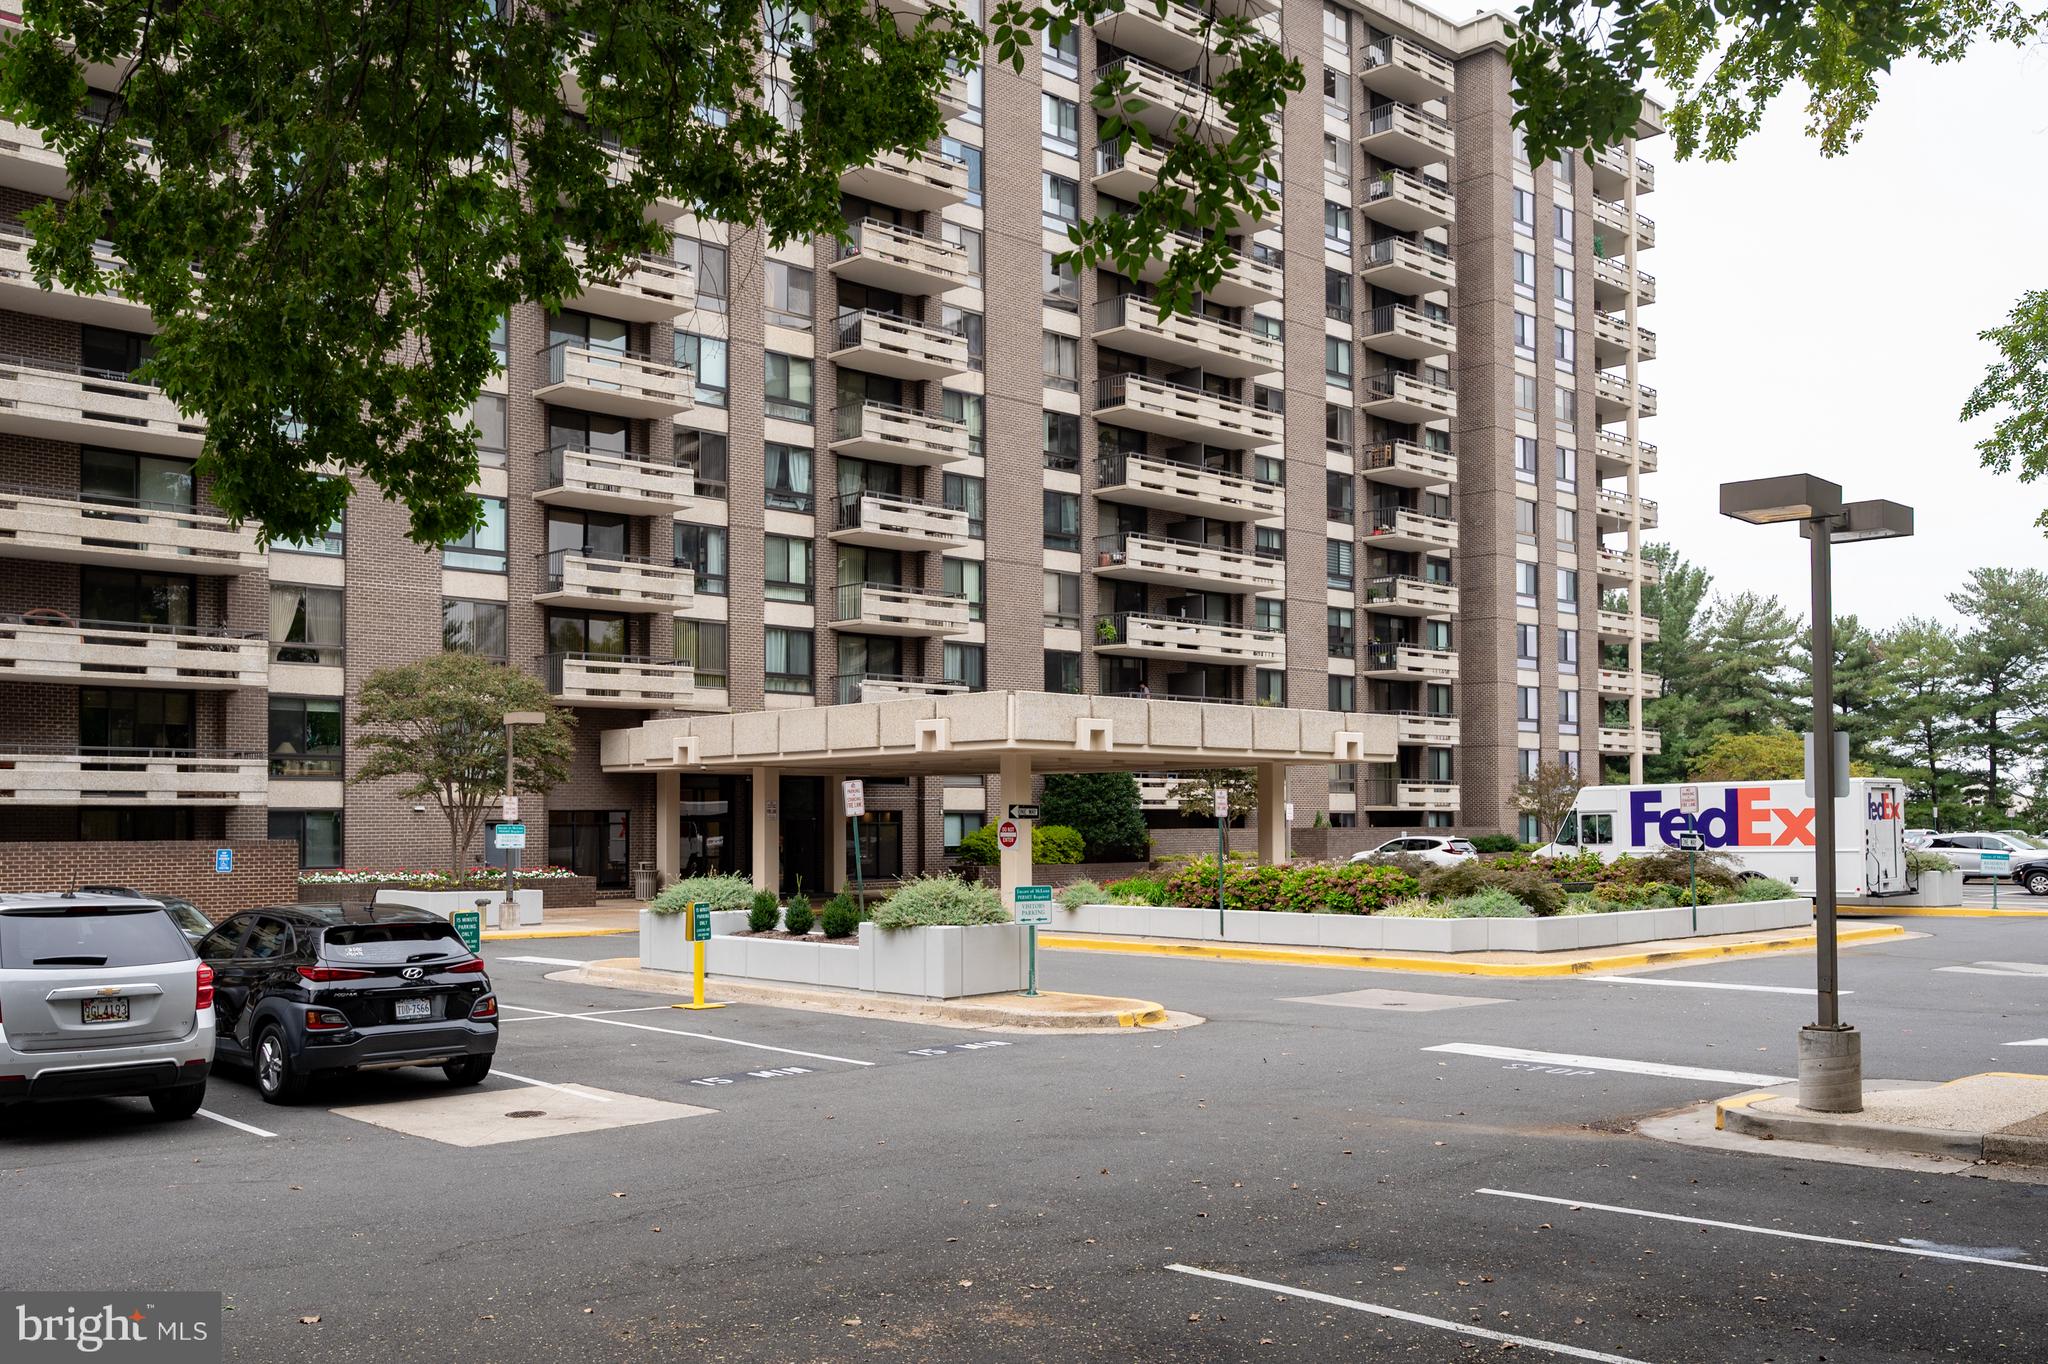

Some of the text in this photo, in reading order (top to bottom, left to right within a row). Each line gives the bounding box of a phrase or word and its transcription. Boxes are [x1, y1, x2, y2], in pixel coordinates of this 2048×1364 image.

[1868, 793, 1900, 820] FedEx
[1630, 787, 1816, 848] FedEx
[907, 1040, 1013, 1056] 15 MIN
[690, 1066, 813, 1086] 15 MIN
[1502, 1063, 1596, 1076] STOP
